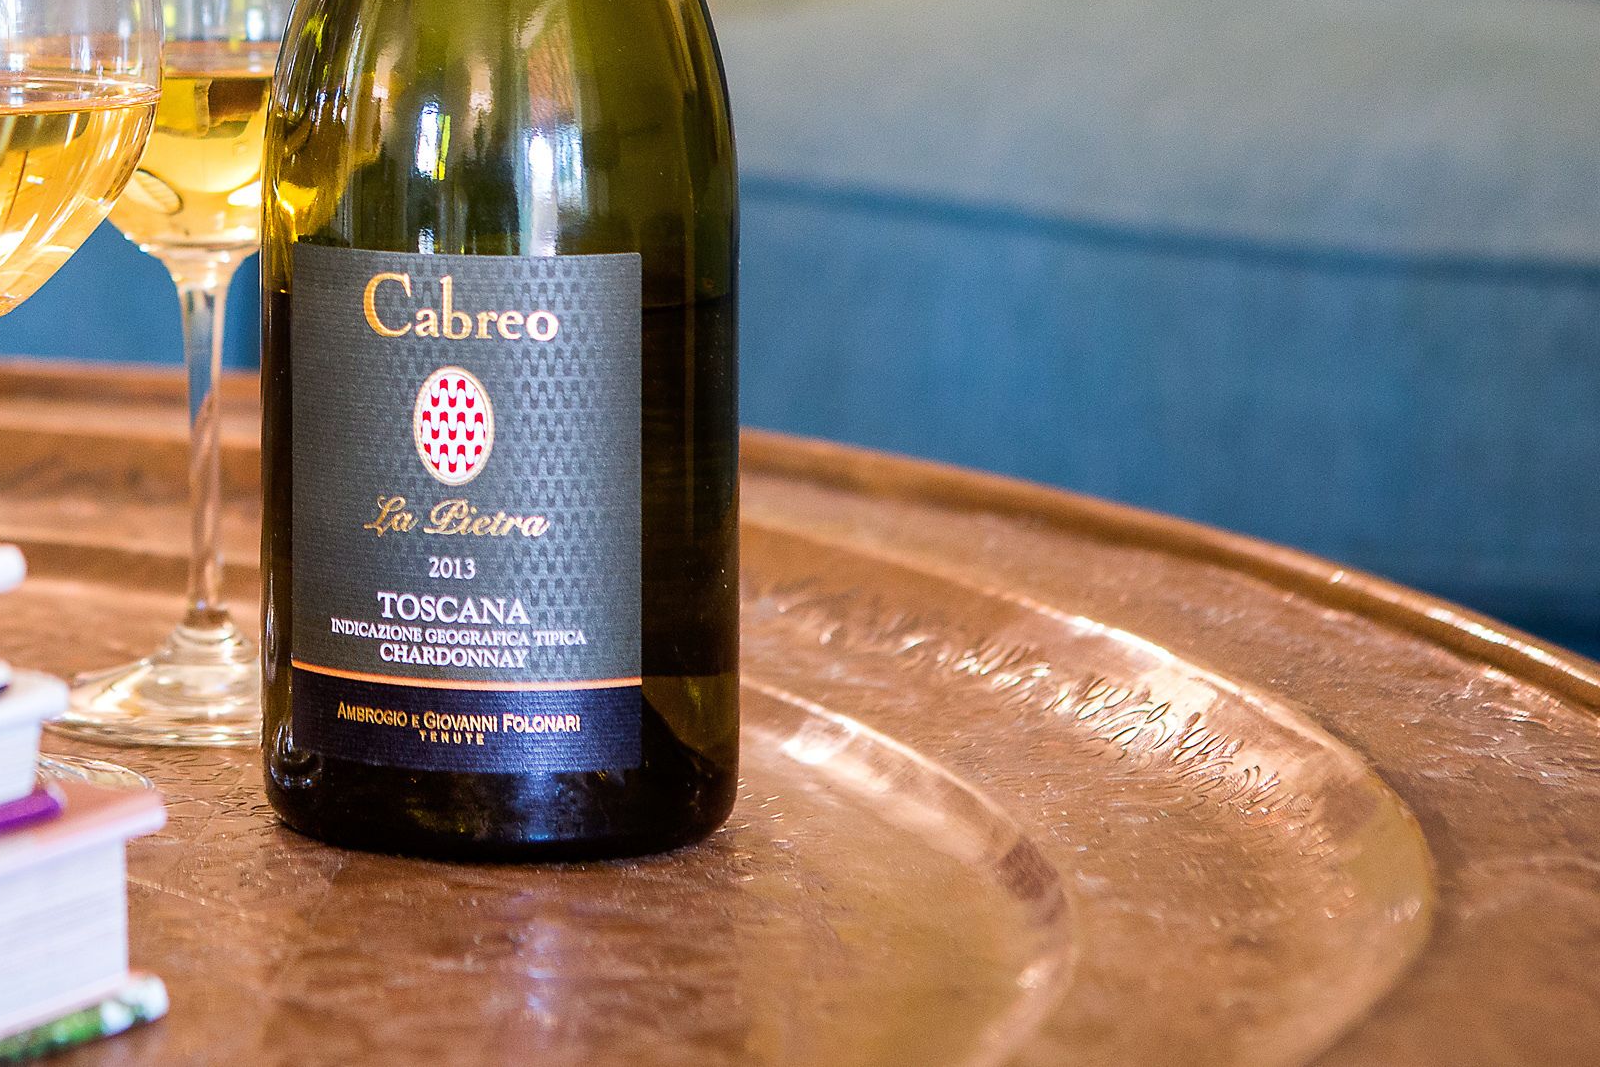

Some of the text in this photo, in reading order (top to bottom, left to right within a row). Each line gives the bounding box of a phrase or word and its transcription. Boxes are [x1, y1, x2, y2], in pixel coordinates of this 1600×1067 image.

[363, 272, 559, 341] Cabreo
[363, 495, 550, 537] La Pietra
[428, 557, 477, 580] 2013
[377, 591, 530, 625] TOSCANA
[330, 617, 587, 647] INDICAZIONE GEOGRAFICA TIPICA
[379, 643, 529, 669] CHARDONNAY
[337, 701, 581, 733] AMBROGIO E GIOVANNI FOLONARI
[419, 730, 485, 746] TENUTE
